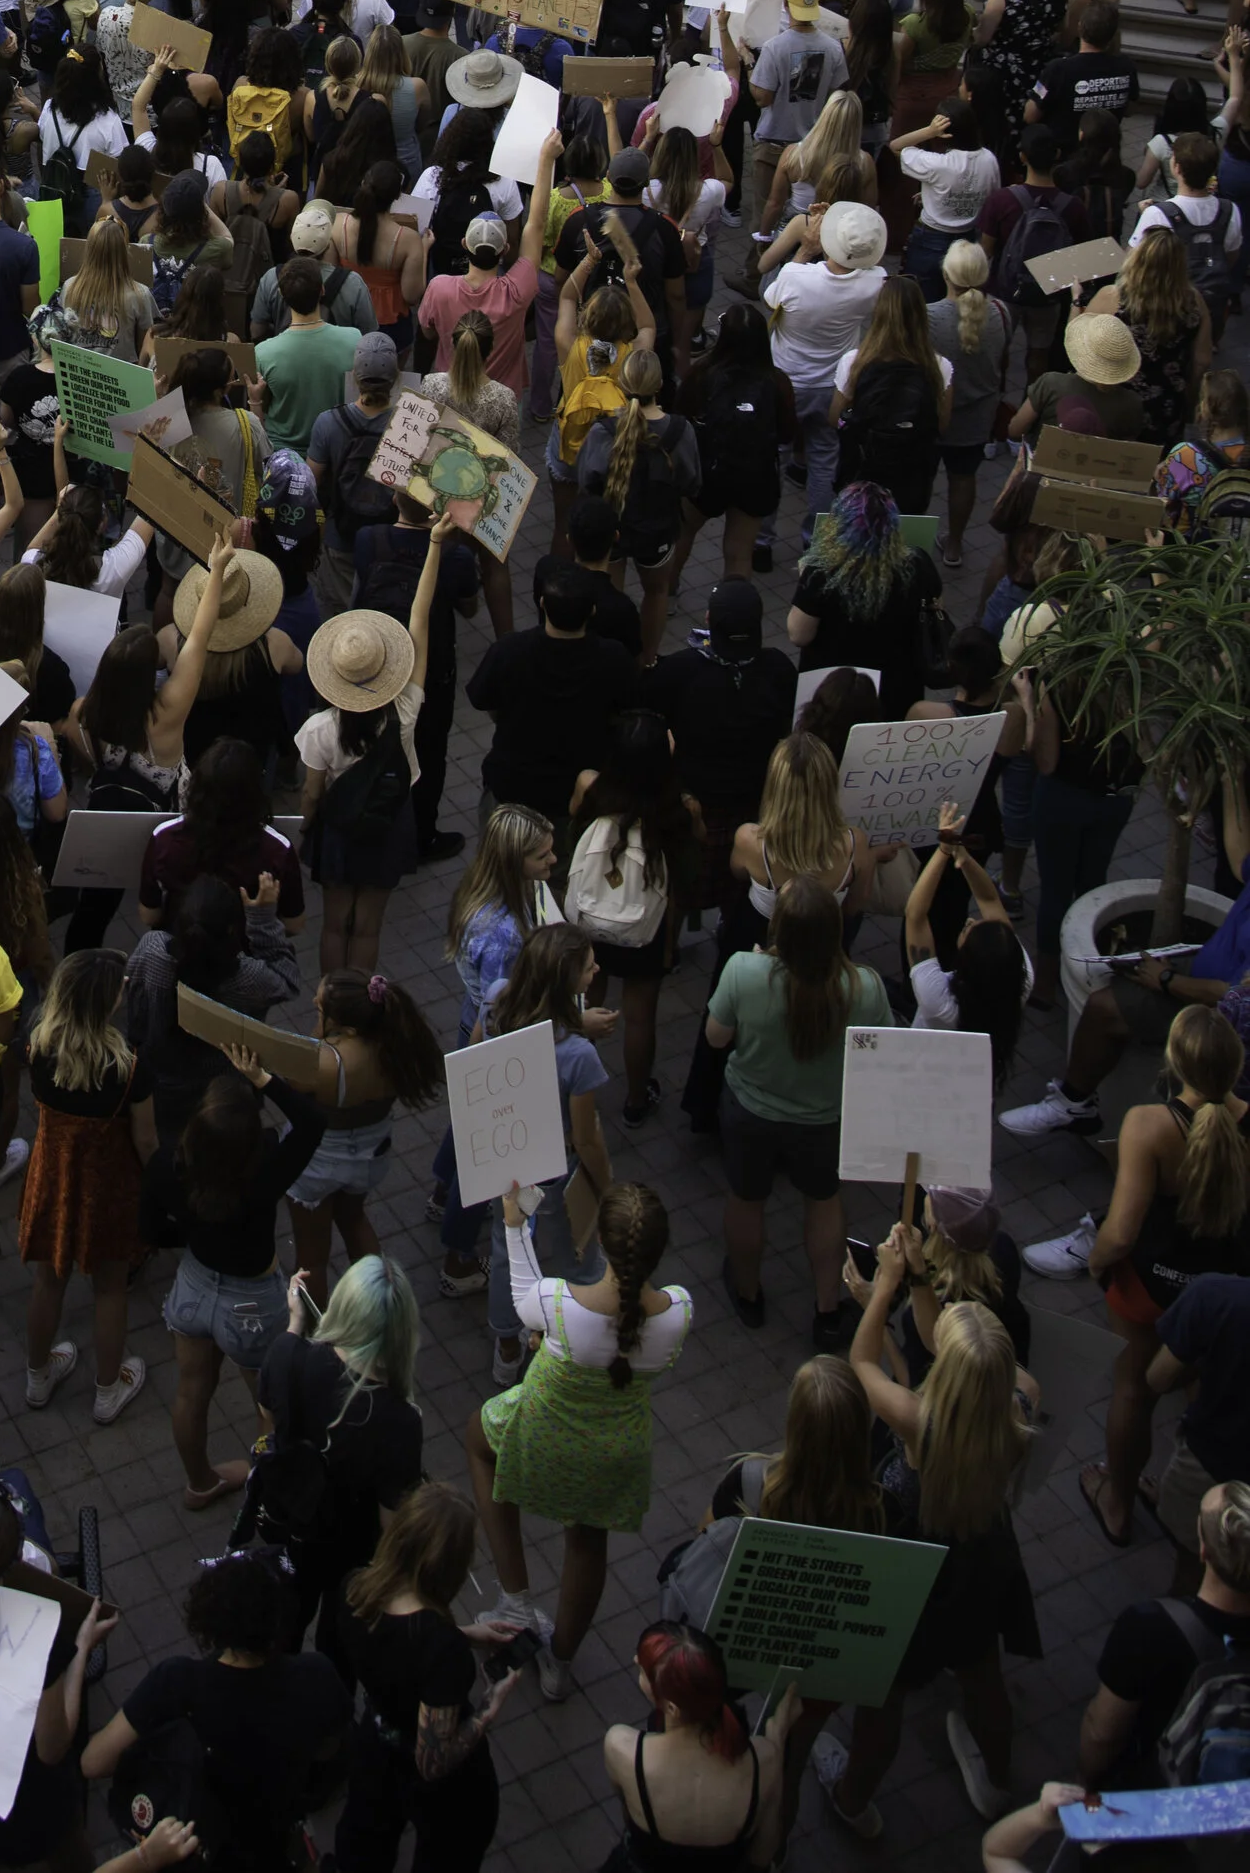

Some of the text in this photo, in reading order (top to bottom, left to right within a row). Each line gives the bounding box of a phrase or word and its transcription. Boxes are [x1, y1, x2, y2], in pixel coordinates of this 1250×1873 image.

[1090, 76, 1130, 88] DEPORTING
[68, 363, 119, 386] HIT THE STREETS
[69, 372, 127, 399] GREEN OUR POWER
[71, 382, 131, 408] LOCALIZE OUR FOOD
[72, 392, 118, 414] WATER FOR ALL
[73, 401, 91, 415] BUILD
[75, 411, 89, 423] FUEL
[401, 399, 436, 424] UNITED
[76, 420, 88, 431] TRY
[77, 429, 93, 442] TAKE
[93, 435, 104, 446] THE
[402, 416, 421, 437] FOR
[398, 433, 408, 444] A
[376, 454, 412, 478] FUTURE
[509, 466, 528, 489] ONE
[500, 477, 524, 505] EARTH
[490, 509, 508, 531] ONE
[476, 515, 506, 551] CHANCE
[862, 738, 968, 766] CLEAN
[843, 753, 989, 789] ENERGY
[464, 1056, 526, 1107] ECO
[492, 1102, 515, 1121] over
[470, 1118, 529, 1168] EGO
[762, 1550, 865, 1577] HIT THE STREETS
[756, 1564, 872, 1592] GREEN OUR POWER
[747, 1592, 838, 1617] WATER FOR ALL
[751, 1578, 870, 1607] LOCALIZE OUR FOOD
[736, 1619, 819, 1643] FUEL CHANGE
[741, 1605, 887, 1638] BUILD POLITICAL POWER
[726, 1647, 815, 1670] TAKE THE LEAP
[731, 1633, 841, 1660] TRY PLANT-BASED
